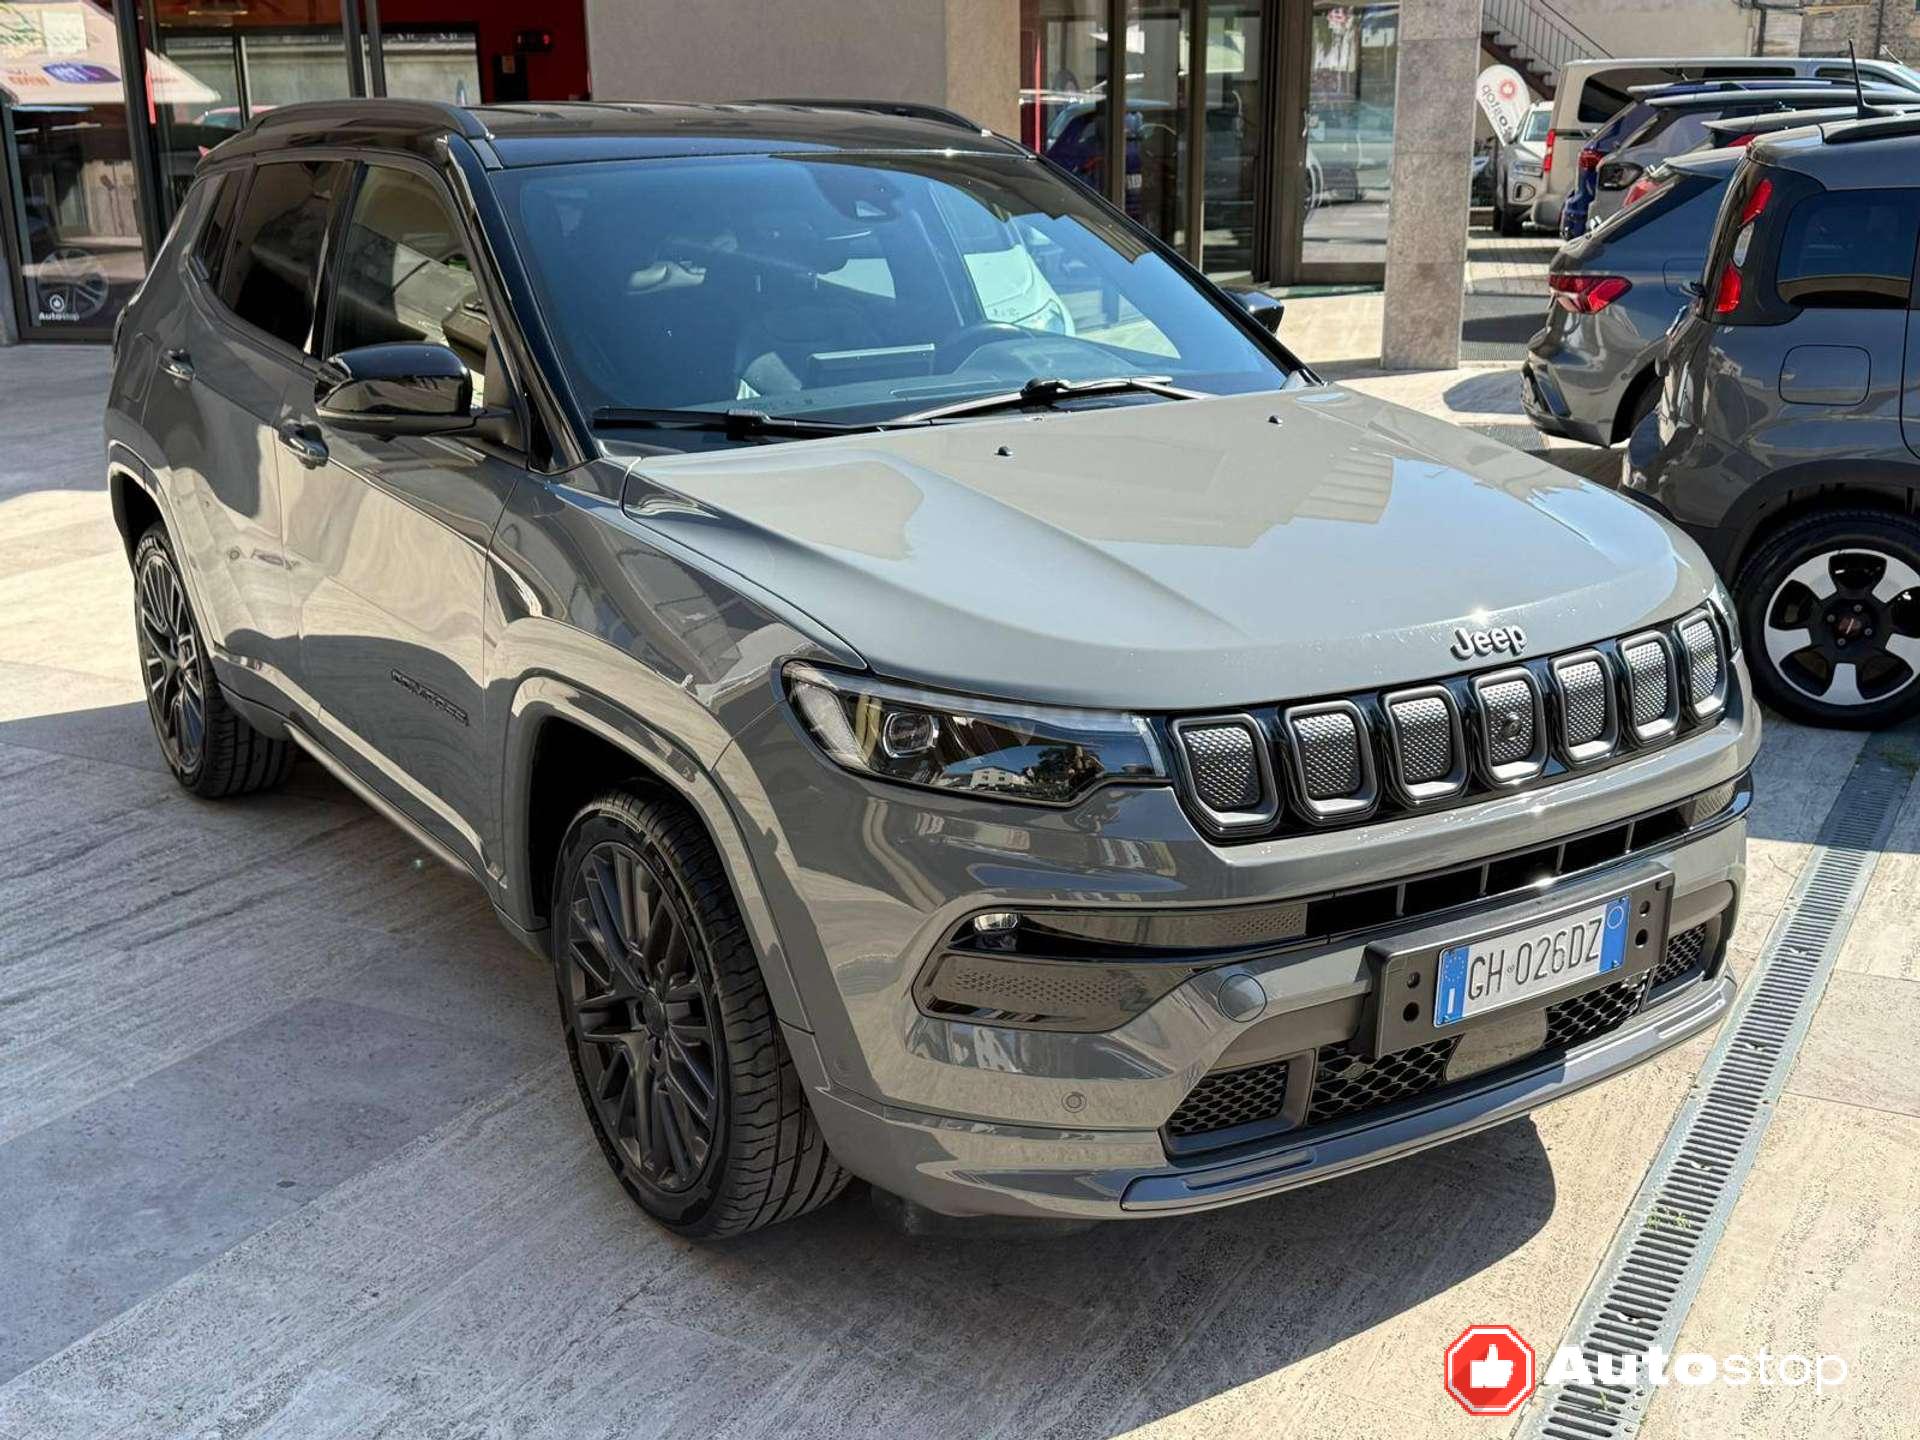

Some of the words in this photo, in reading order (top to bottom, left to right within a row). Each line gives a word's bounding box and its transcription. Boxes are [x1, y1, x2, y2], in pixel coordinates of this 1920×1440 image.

[1450, 625, 1528, 661] Jeep
[1468, 949, 1505, 1000] GH
[1515, 917, 1603, 986] 026DZ
